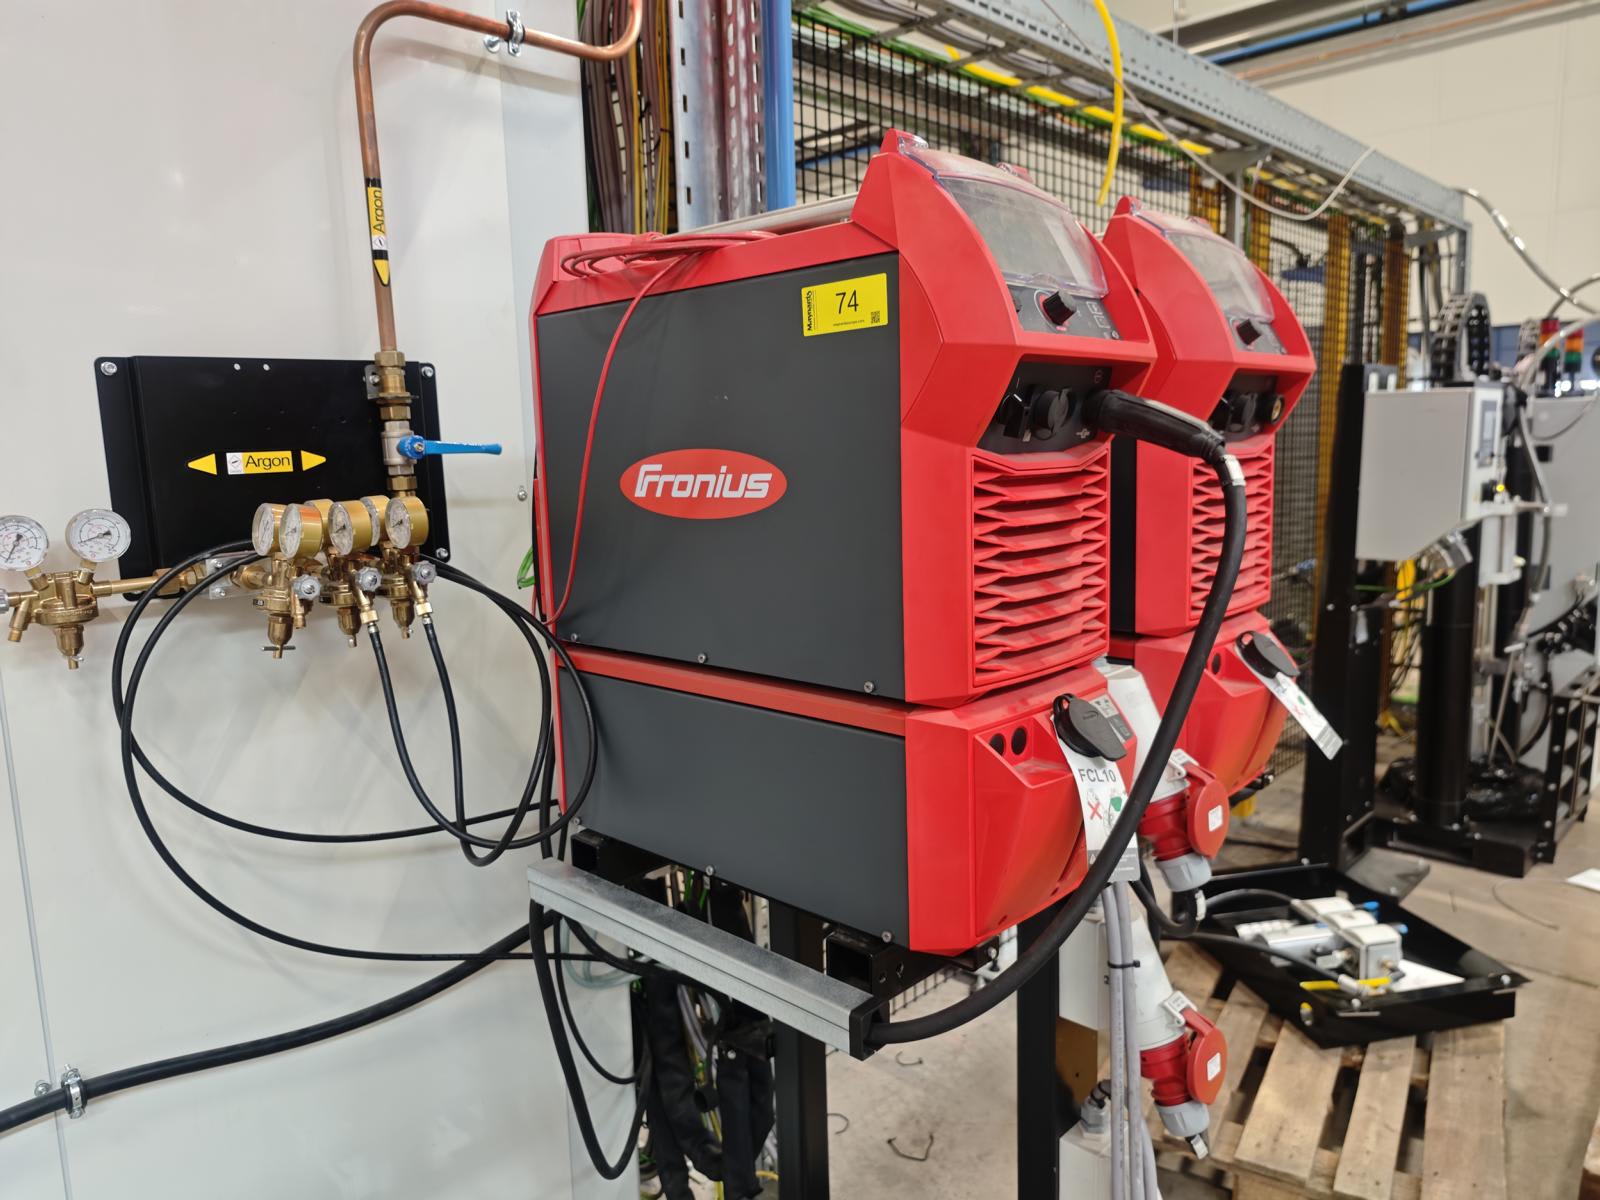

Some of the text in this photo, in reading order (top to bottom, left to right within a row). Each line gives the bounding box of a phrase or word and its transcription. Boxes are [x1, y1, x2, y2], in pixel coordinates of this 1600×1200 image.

[373, 190, 385, 234] Argon
[836, 290, 858, 314] 74
[245, 455, 290, 470] Argon
[634, 463, 772, 498] Fronius
[1078, 768, 1116, 783] FCL10
